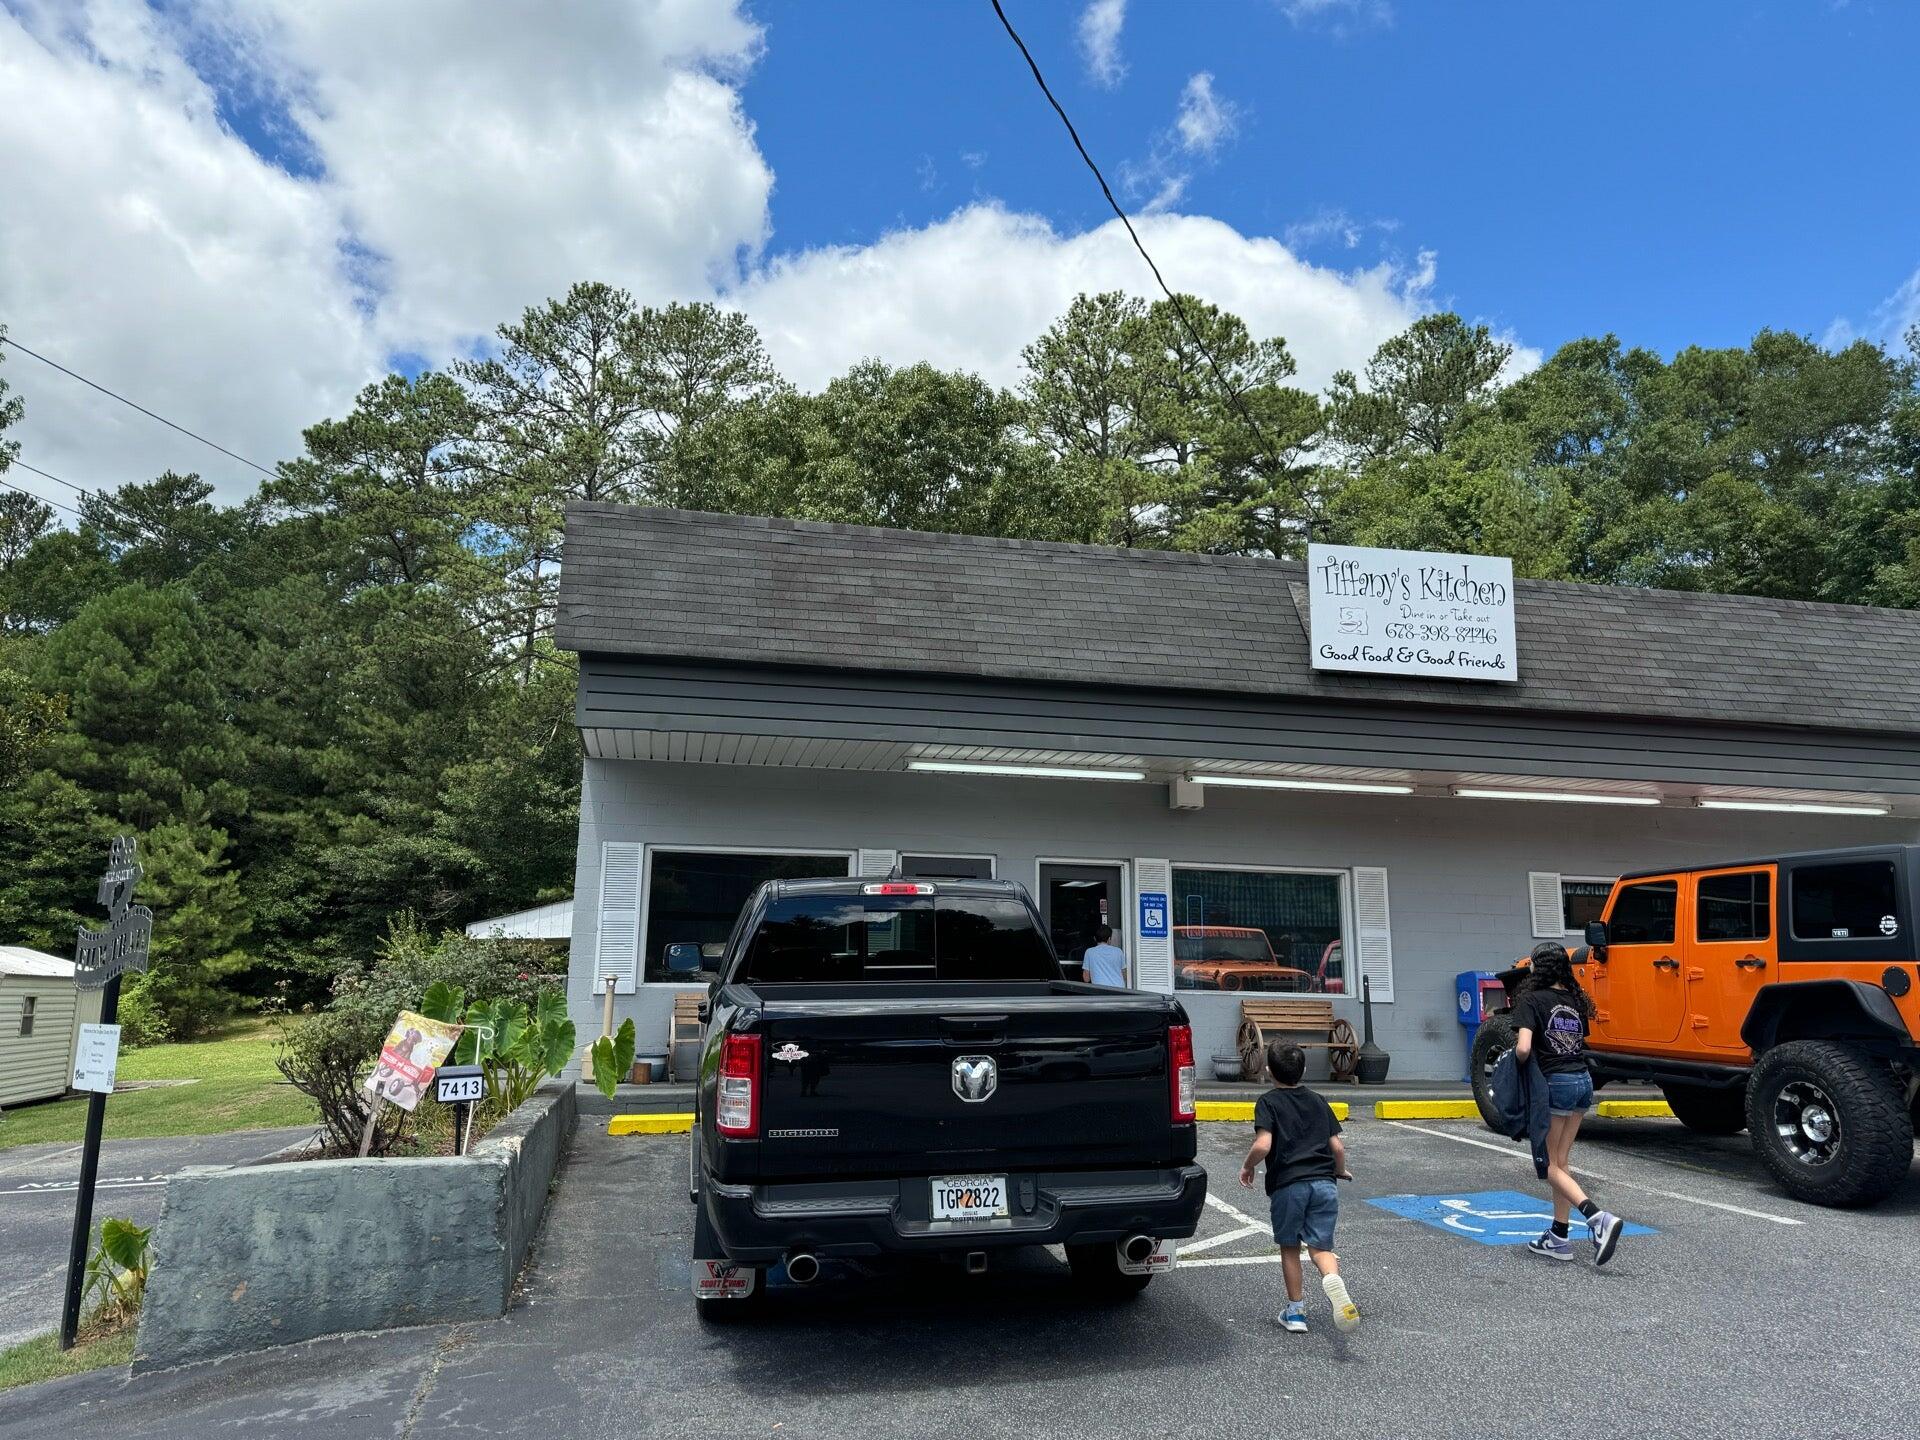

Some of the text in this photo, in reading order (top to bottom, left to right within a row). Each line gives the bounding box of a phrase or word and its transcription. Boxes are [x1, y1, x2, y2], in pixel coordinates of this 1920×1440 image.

[1317, 555, 1506, 606] Tiffany's Kitchen
[1400, 604, 1491, 623] Dine in or Take out
[1385, 622, 1497, 645] 678-398-8446
[1320, 644, 1506, 669] Good Food & Good Friends
[441, 1080, 480, 1097] 7413
[769, 1128, 839, 1138] BIGHORN
[946, 1179, 990, 1188] GEORGIA
[937, 1187, 1000, 1210] TGP2822
